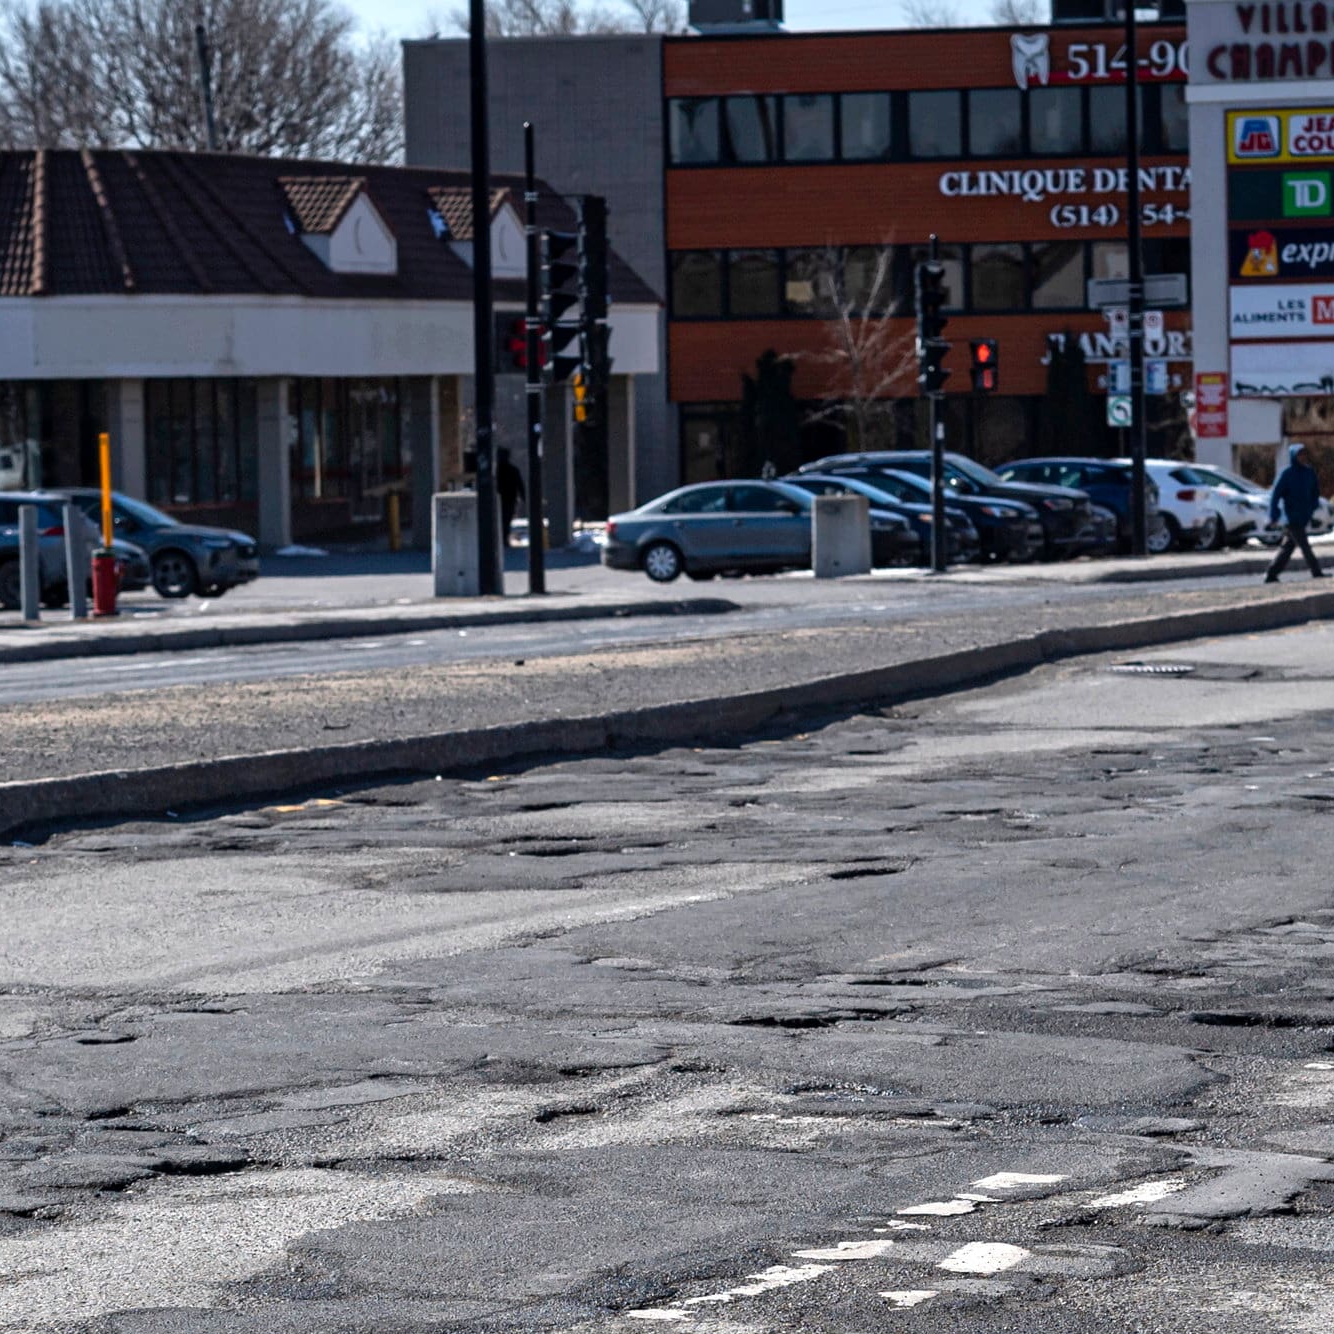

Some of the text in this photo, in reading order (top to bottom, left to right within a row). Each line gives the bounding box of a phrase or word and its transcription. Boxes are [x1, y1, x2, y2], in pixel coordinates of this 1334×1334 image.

[939, 169, 1086, 202] CLINIQUE
[1287, 180, 1326, 208] TD
[1050, 204, 1119, 227] (514)
[1278, 300, 1305, 310] LES
[1234, 312, 1306, 323] ALIMENTS
